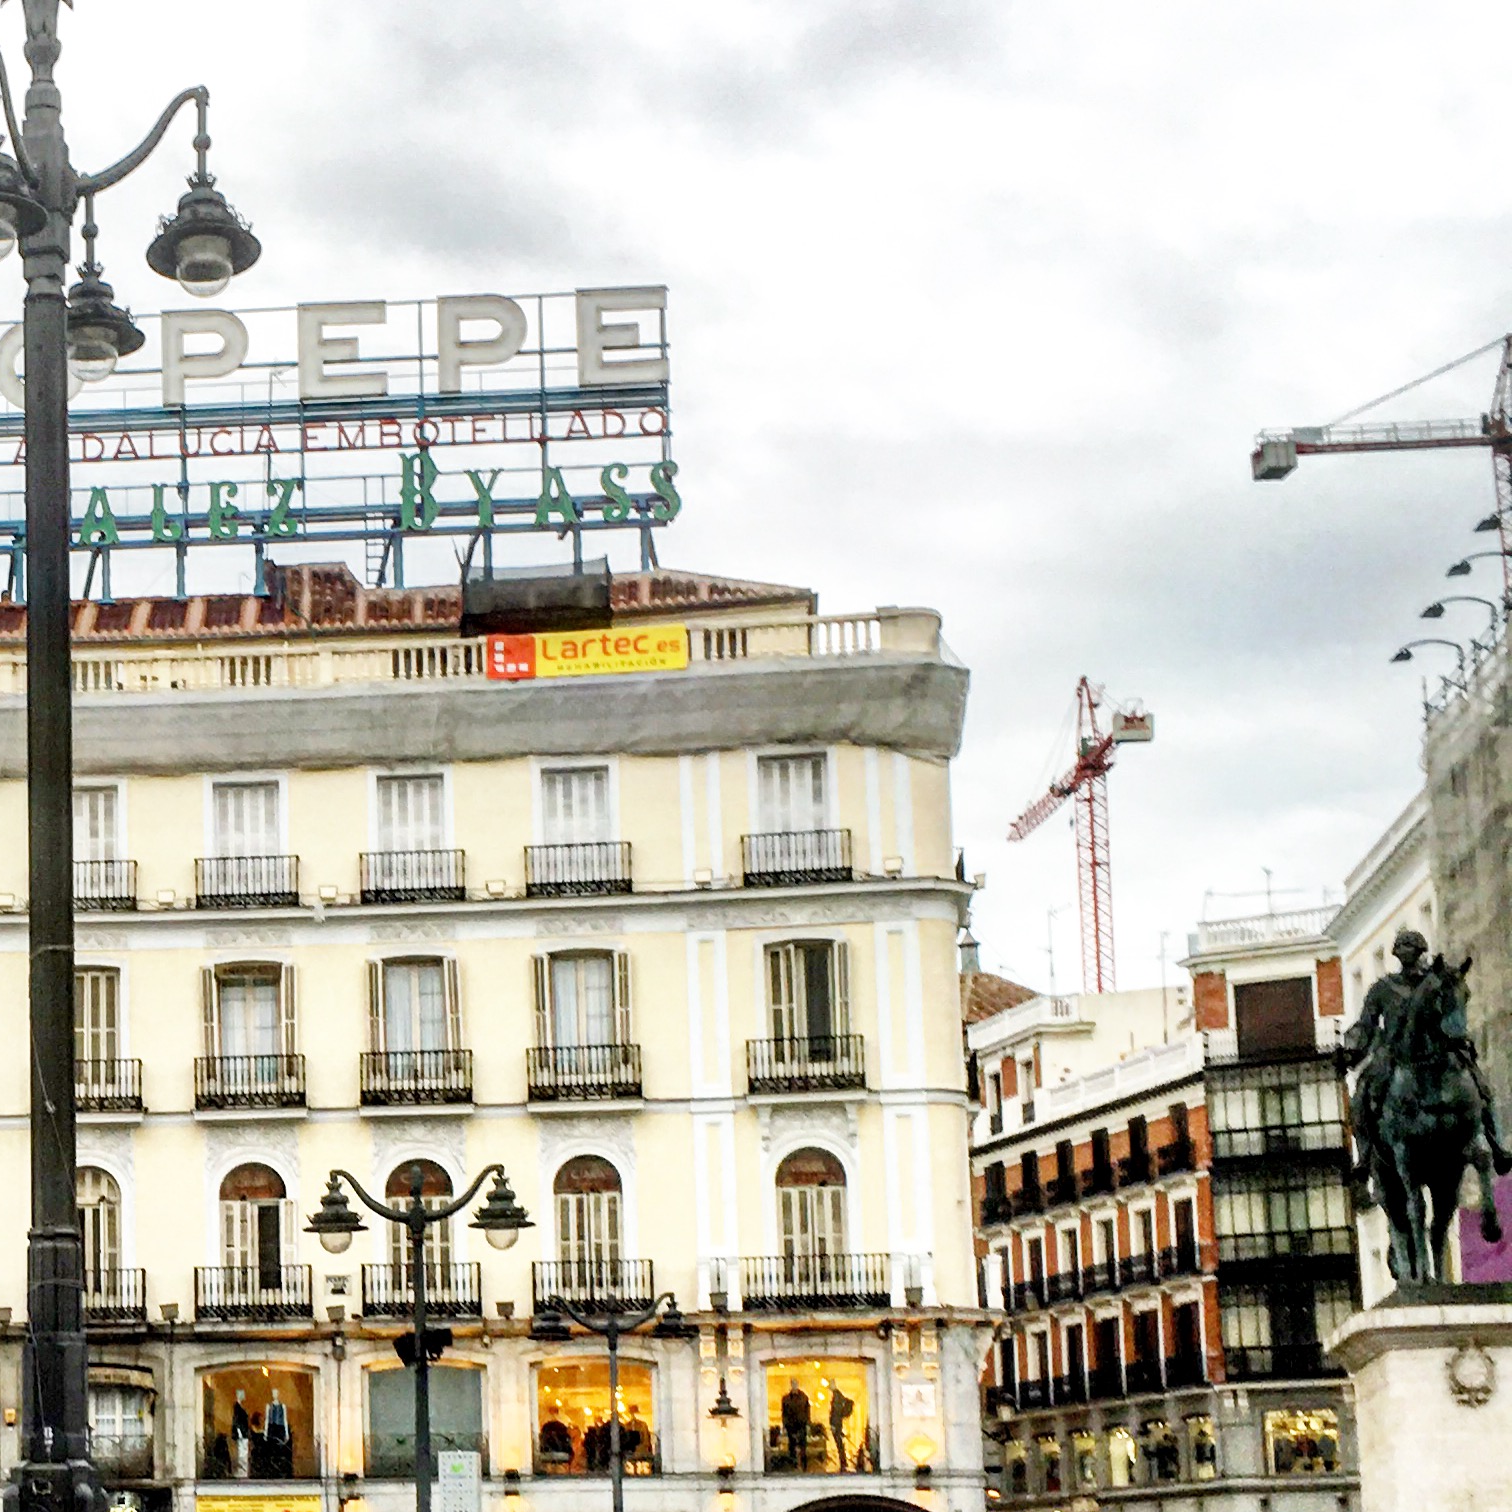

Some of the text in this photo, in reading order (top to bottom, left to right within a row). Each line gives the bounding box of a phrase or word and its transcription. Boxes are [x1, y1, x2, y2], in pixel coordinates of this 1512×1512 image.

[161, 286, 669, 408] PEPE
[303, 406, 667, 452] EMBOTELLADO
[399, 450, 682, 532] BYASS
[542, 632, 649, 661] Lartec
